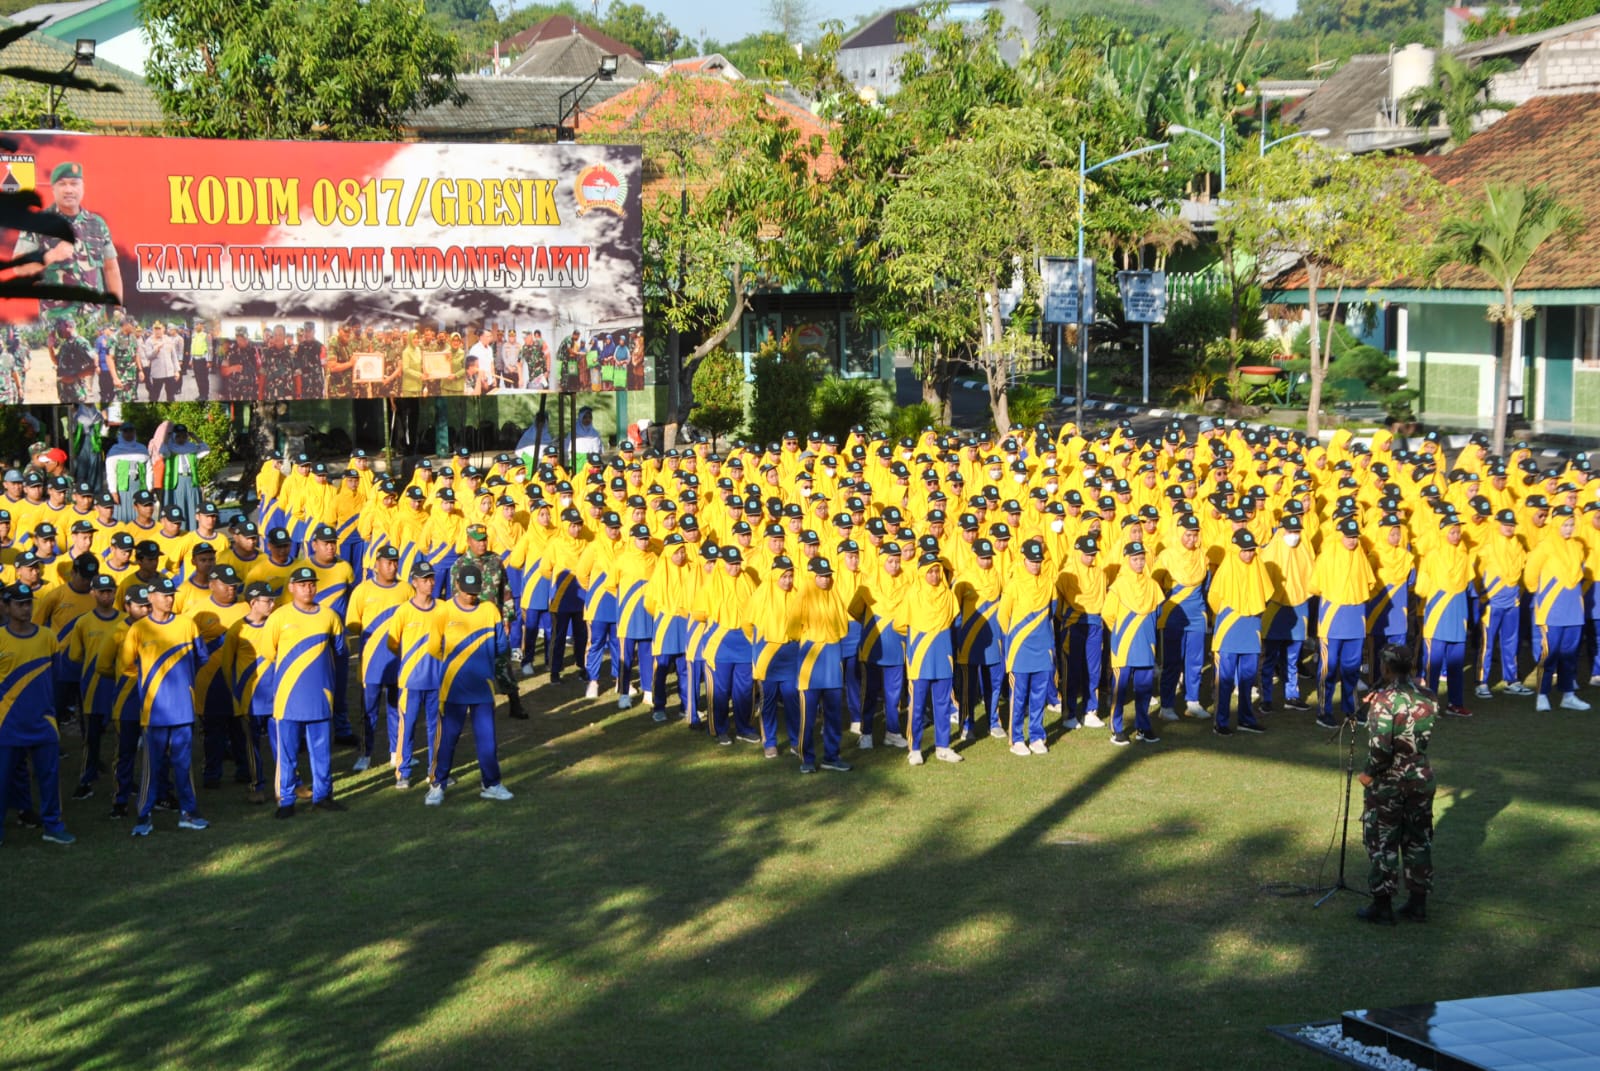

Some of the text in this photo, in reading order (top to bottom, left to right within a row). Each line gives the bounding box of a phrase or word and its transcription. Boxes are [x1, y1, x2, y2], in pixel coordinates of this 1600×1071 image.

[167, 175, 561, 227] KODIM 0817/GRESIK
[136, 244, 591, 291] KAMI UNTUKMU INDONESIAKU
